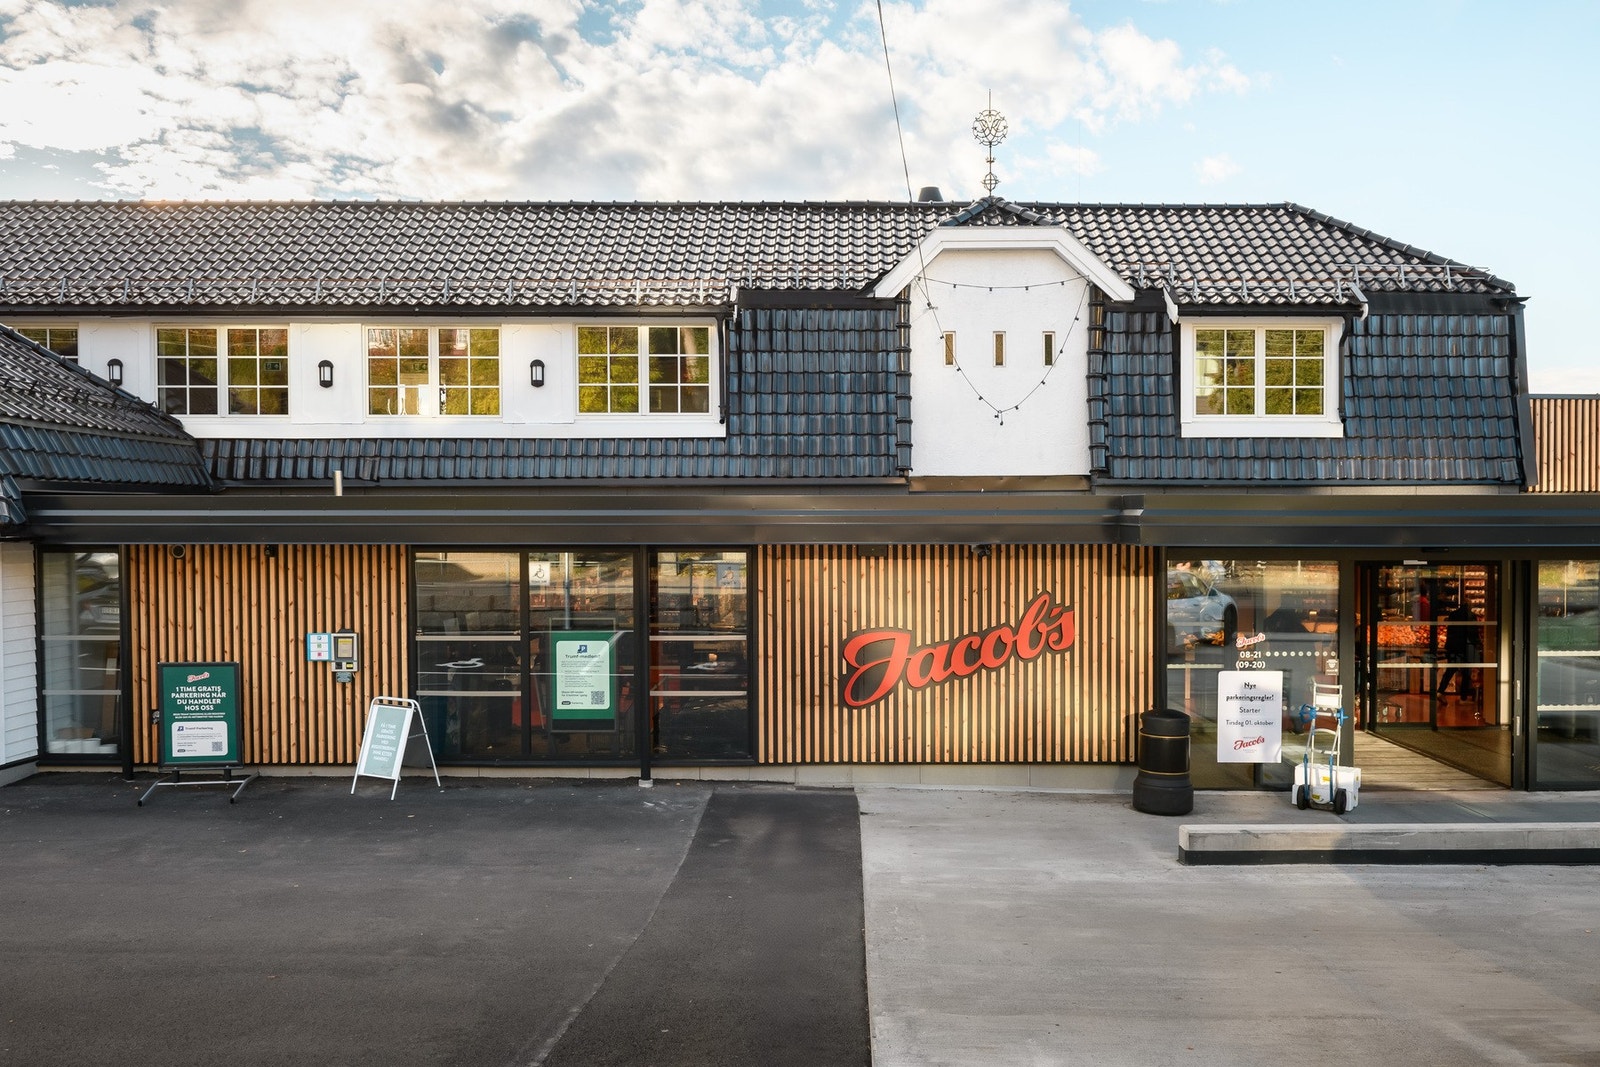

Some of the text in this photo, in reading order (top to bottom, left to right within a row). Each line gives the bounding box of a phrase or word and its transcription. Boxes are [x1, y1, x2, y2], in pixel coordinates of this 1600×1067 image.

[843, 592, 1075, 707] Jacob's
[1239, 650, 1262, 659] 08-21
[1235, 660, 1266, 669] (09-20)
[1243, 682, 1257, 690] Nye
[211, 690, 227, 698] NÅR
[1225, 694, 1274, 702] parkeringsregler!
[1239, 706, 1261, 714] Starter
[1225, 719, 1245, 727] Tirsdag
